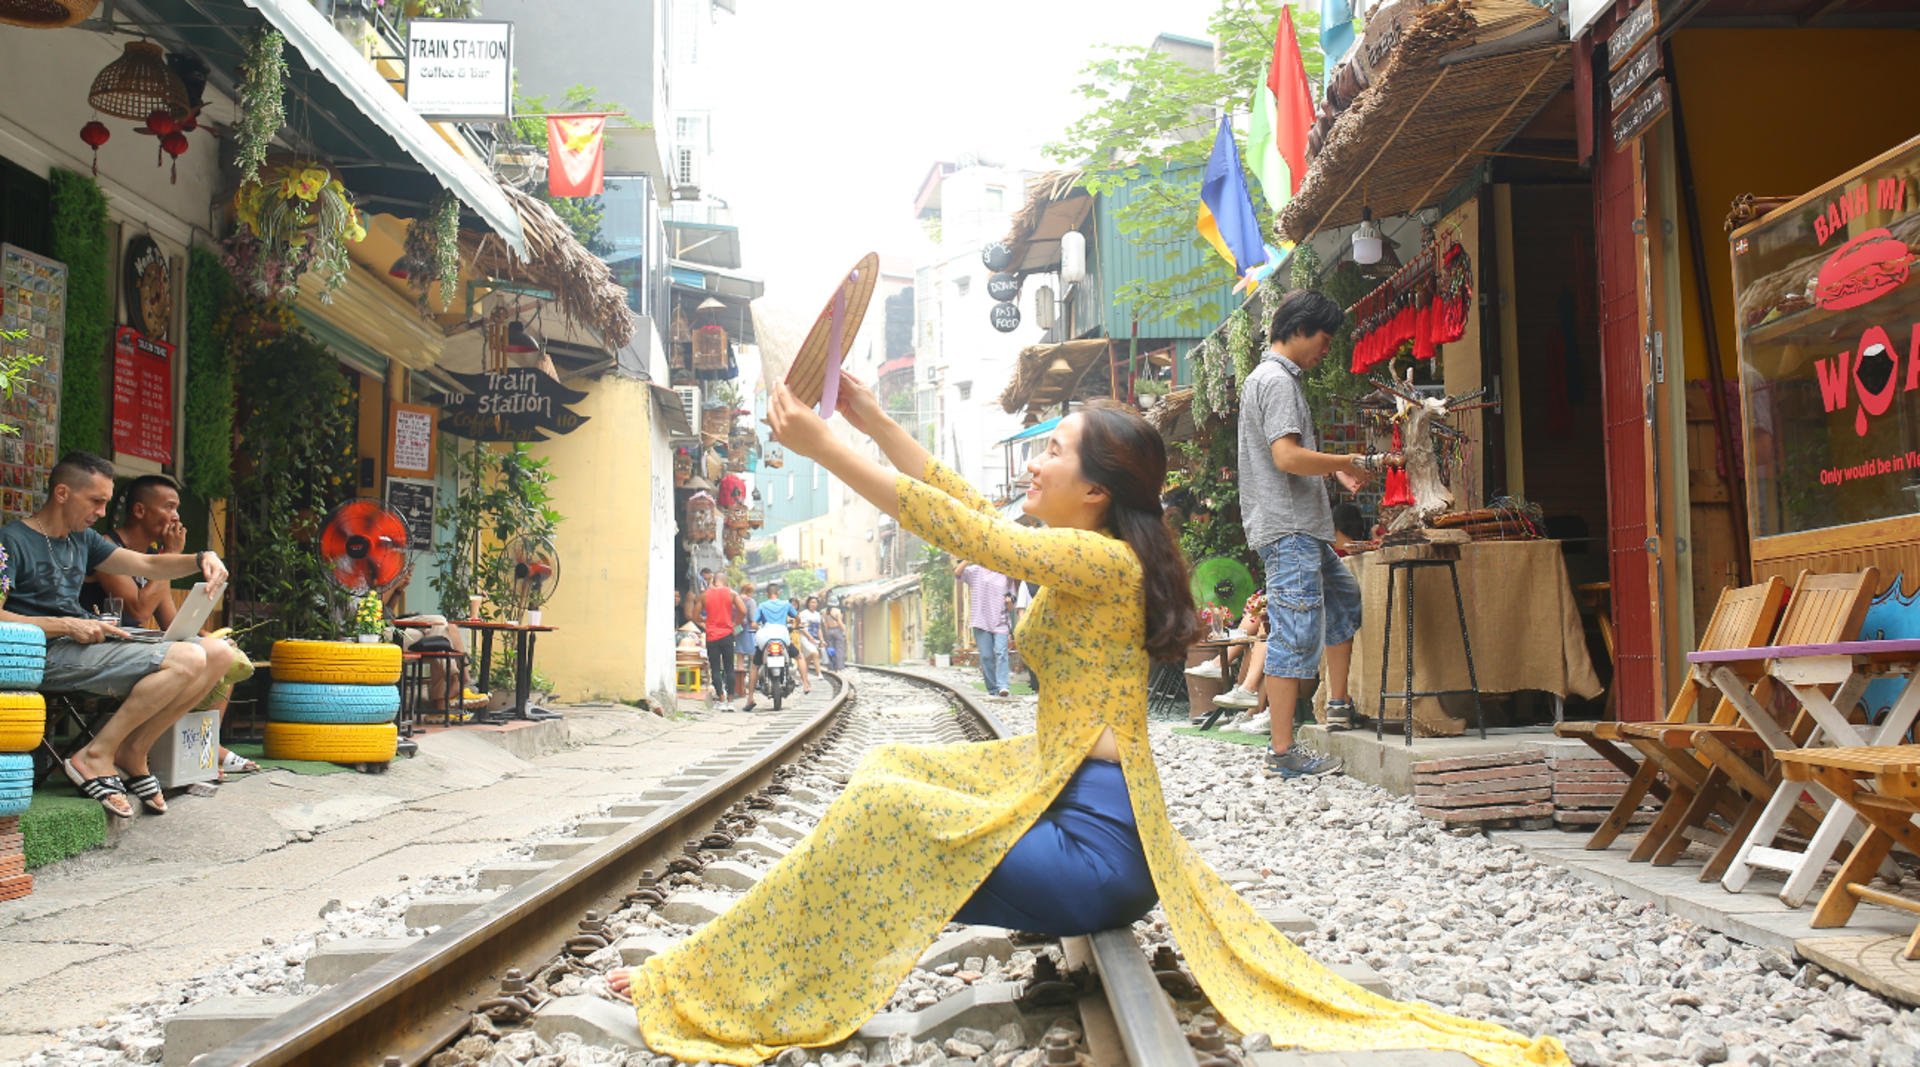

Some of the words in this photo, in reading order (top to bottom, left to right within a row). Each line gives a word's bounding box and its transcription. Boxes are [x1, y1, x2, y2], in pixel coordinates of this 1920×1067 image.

[411, 39, 449, 59] TRAIN
[452, 39, 507, 60] STATION
[420, 66, 455, 78] Coffee
[469, 68, 491, 79] Bar
[1813, 183, 1869, 247] BANH
[1876, 178, 1906, 212] MI
[995, 306, 1016, 318] FAST
[995, 317, 1019, 329] FOOD
[485, 370, 540, 396] Train
[1820, 466, 1842, 486] Only
[1844, 458, 1876, 480] would
[1877, 457, 1892, 475] be
[1892, 454, 1904, 472] in
